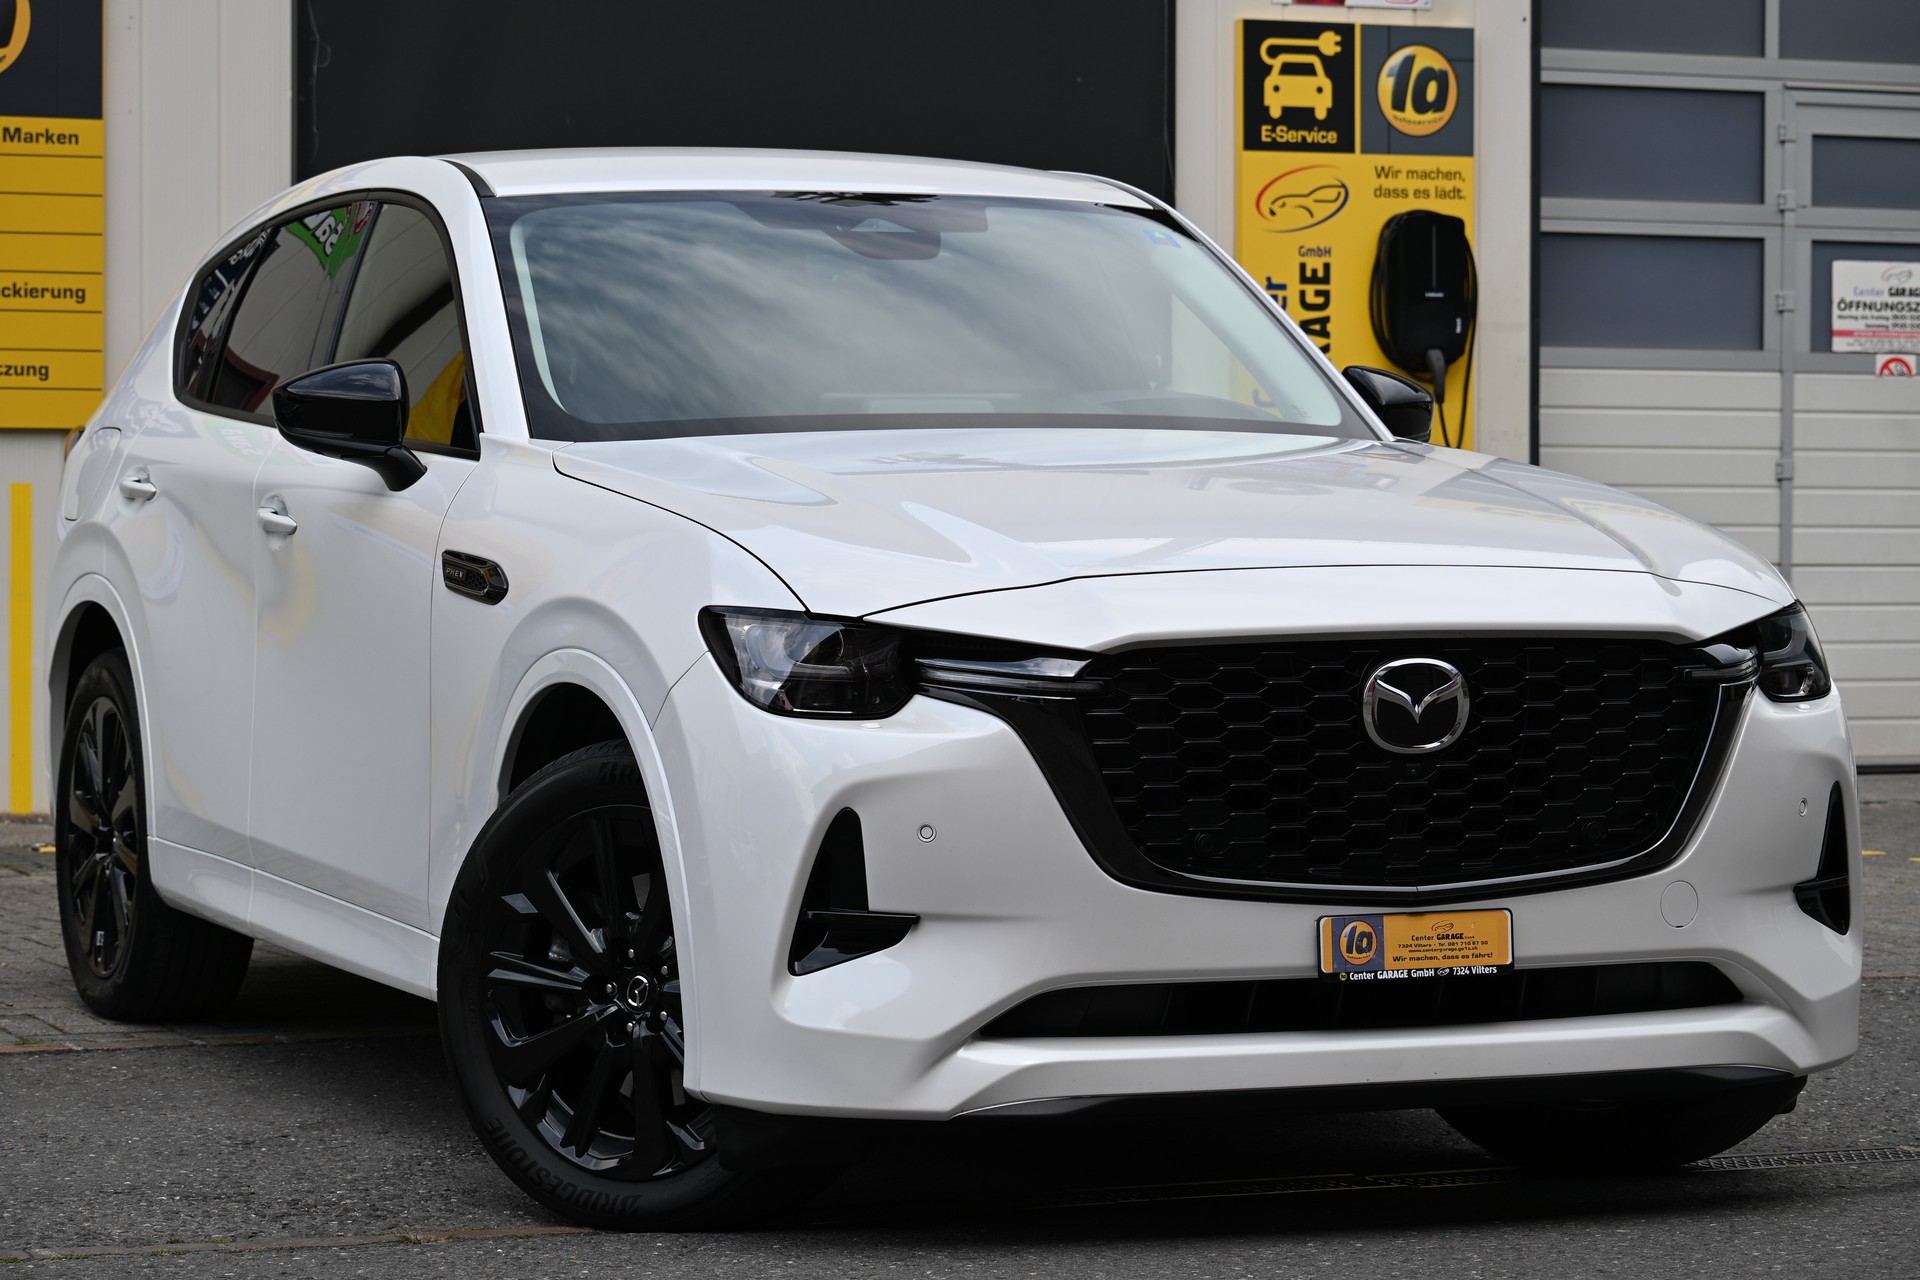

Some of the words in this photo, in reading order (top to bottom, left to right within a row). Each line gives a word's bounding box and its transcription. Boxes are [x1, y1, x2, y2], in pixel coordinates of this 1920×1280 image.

[1384, 54, 1449, 115] 1a
[2, 127, 80, 145] Marken
[1261, 125, 1338, 144] E-Service
[1374, 166, 1402, 180] Wir
[1406, 168, 1466, 182] machen,
[1373, 185, 1409, 199] dass
[1413, 188, 1430, 199] es
[1434, 185, 1466, 200] lädt.
[1298, 246, 1332, 257] GmbH
[1299, 262, 1331, 360] AGE
[446, 567, 464, 578] PHEV
[1344, 925, 1374, 955] 1a
[1436, 933, 1464, 941] GARAGE
[1409, 953, 1440, 961] machen,
[1349, 972, 1375, 981] Center
[1377, 970, 1409, 979] GARAGE
[1411, 969, 1435, 978] GmbH
[1452, 966, 1470, 976] 7324
[1471, 965, 1498, 974] Vilters
[484, 1117, 642, 1216] BRIDGESTONE
